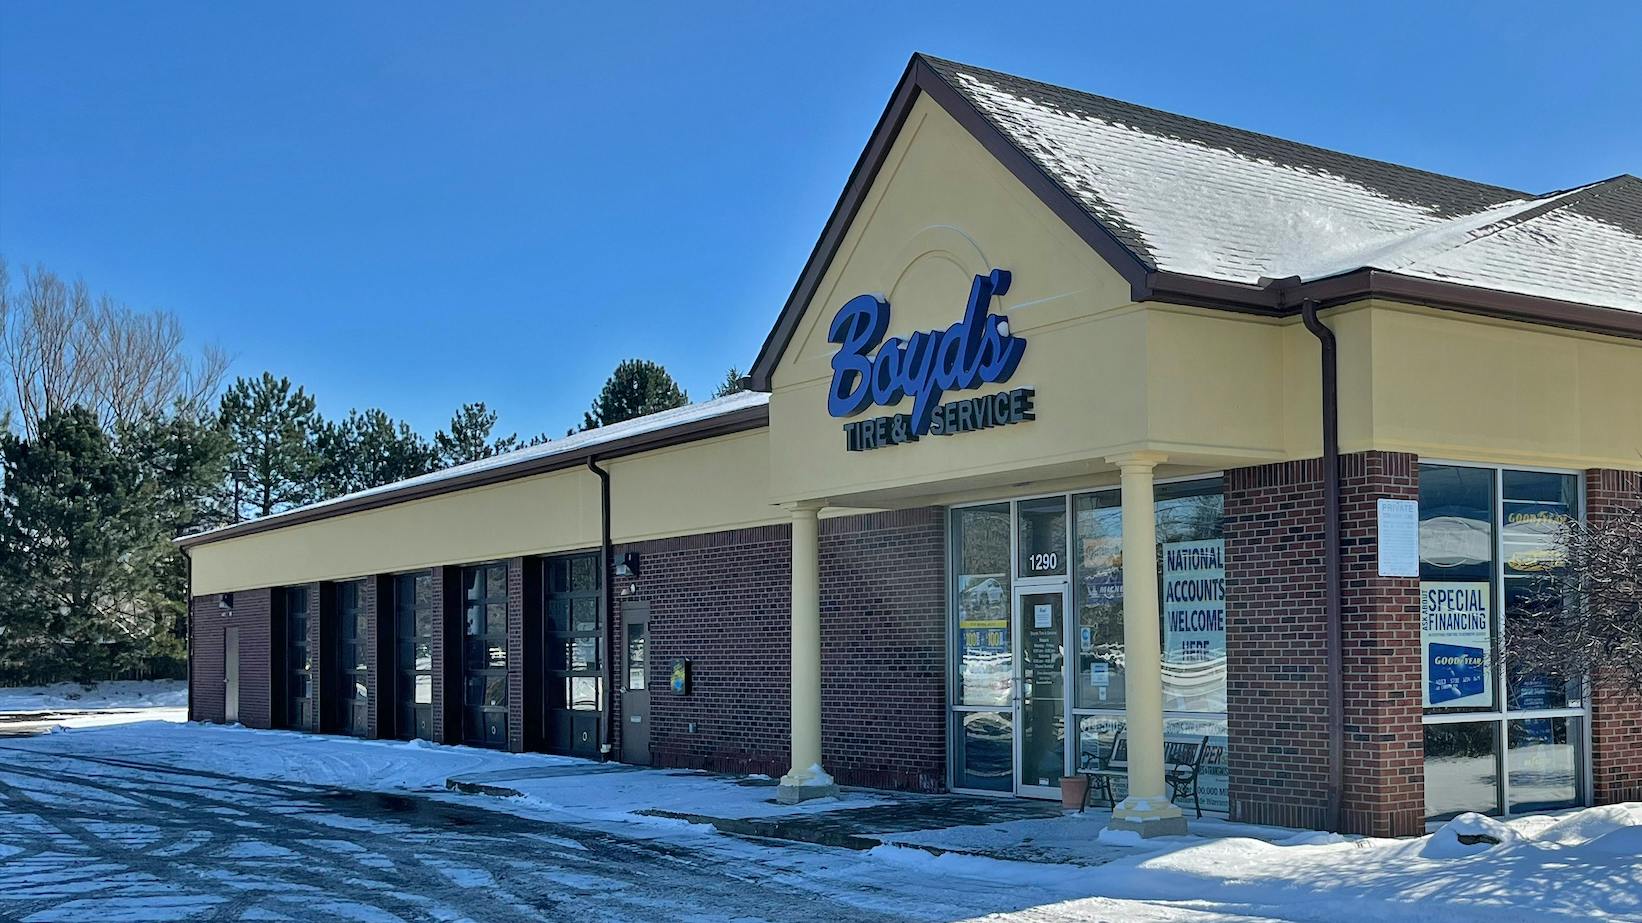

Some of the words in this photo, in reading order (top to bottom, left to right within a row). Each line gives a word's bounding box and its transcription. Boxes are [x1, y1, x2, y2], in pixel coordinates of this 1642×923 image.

[828, 269, 1026, 435] Boyd's
[843, 417, 888, 451] TIRE
[890, 413, 908, 444] &
[930, 389, 1034, 435] SERVICE
[1029, 552, 1057, 571] 1290
[1167, 547, 1223, 571] NATIONAL
[1166, 578, 1225, 602] ACCOUNTS
[1428, 589, 1485, 611] SPECIAL
[1168, 609, 1224, 632] WELCOME
[1428, 613, 1486, 631] FINANCING
[1182, 640, 1210, 661] HERE
[1434, 654, 1482, 666] GOODYEAR
